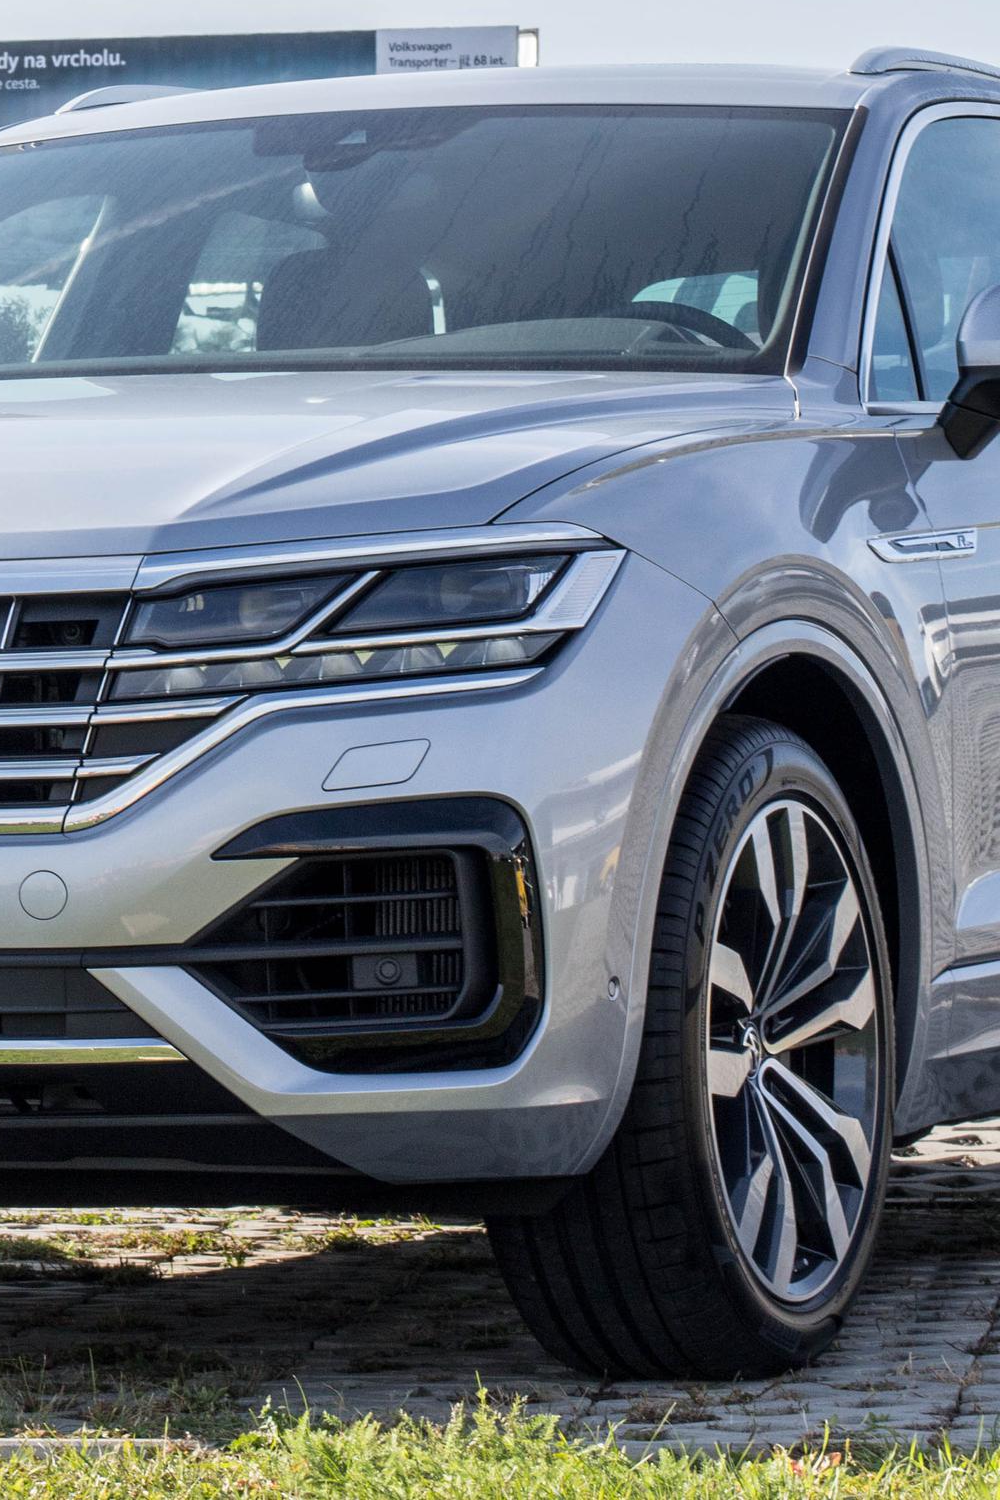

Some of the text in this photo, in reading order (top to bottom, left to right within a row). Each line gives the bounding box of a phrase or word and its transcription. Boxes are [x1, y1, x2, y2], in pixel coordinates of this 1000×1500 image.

[388, 42, 452, 54] Volkswagen
[23, 54, 46, 68] na
[51, 48, 126, 67] vrcholu.
[388, 56, 448, 69] Transporter
[473, 54, 488, 66] 68
[4, 78, 40, 90] cesta.
[703, 773, 755, 894] ZERO
